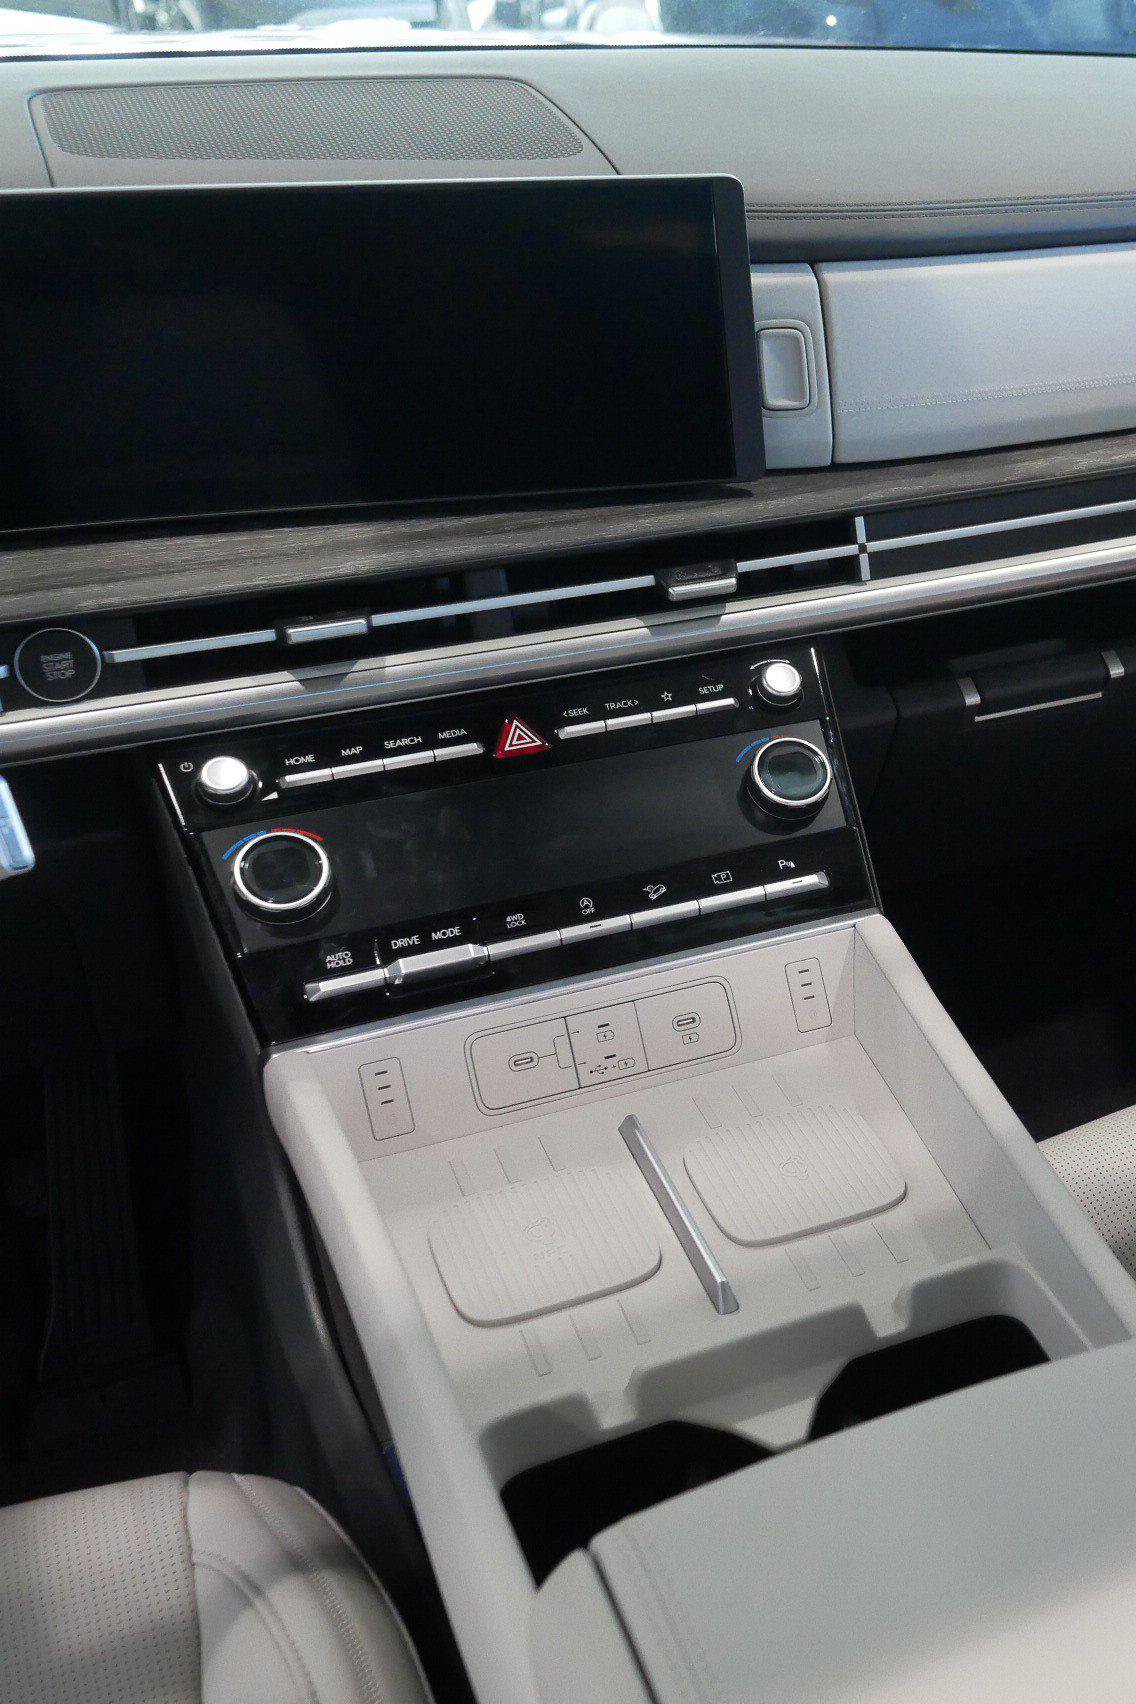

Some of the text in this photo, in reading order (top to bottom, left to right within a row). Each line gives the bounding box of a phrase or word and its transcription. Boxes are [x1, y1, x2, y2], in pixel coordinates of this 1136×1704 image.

[698, 683, 725, 696] SETUP
[437, 727, 468, 740] MEDIA
[383, 735, 423, 750] SEARCH
[340, 745, 364, 757] MAP
[284, 753, 317, 767] HOME
[505, 912, 526, 922] 4WD
[581, 906, 597, 916] OFF
[505, 919, 528, 930] LOCK
[390, 926, 463, 950] DRIVE MODE
[325, 950, 353, 963] AUTO
[325, 957, 354, 970] HOLD
